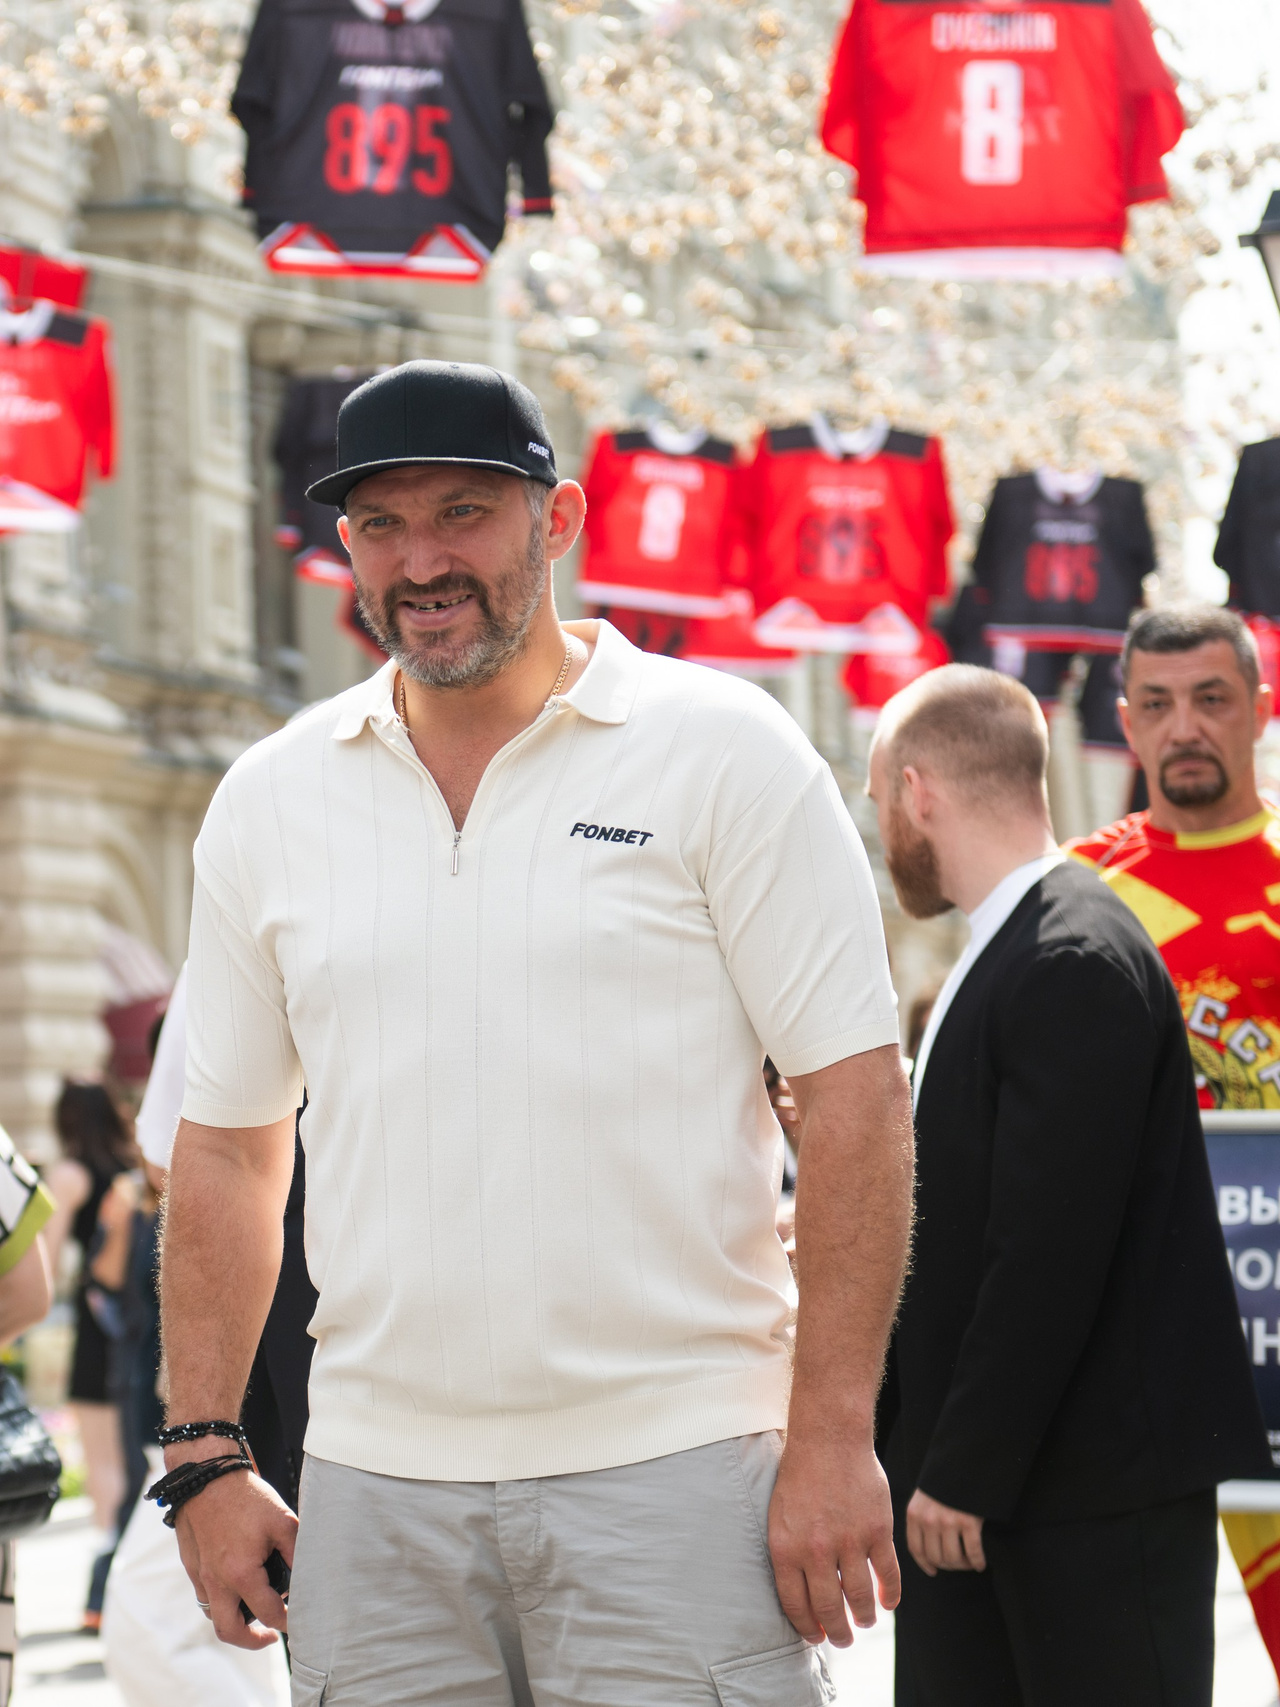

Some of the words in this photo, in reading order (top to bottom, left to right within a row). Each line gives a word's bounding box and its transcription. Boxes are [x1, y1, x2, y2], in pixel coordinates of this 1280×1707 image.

[324, 101, 453, 197] 895
[960, 59, 1023, 186] 8
[569, 822, 654, 847] FONBET
